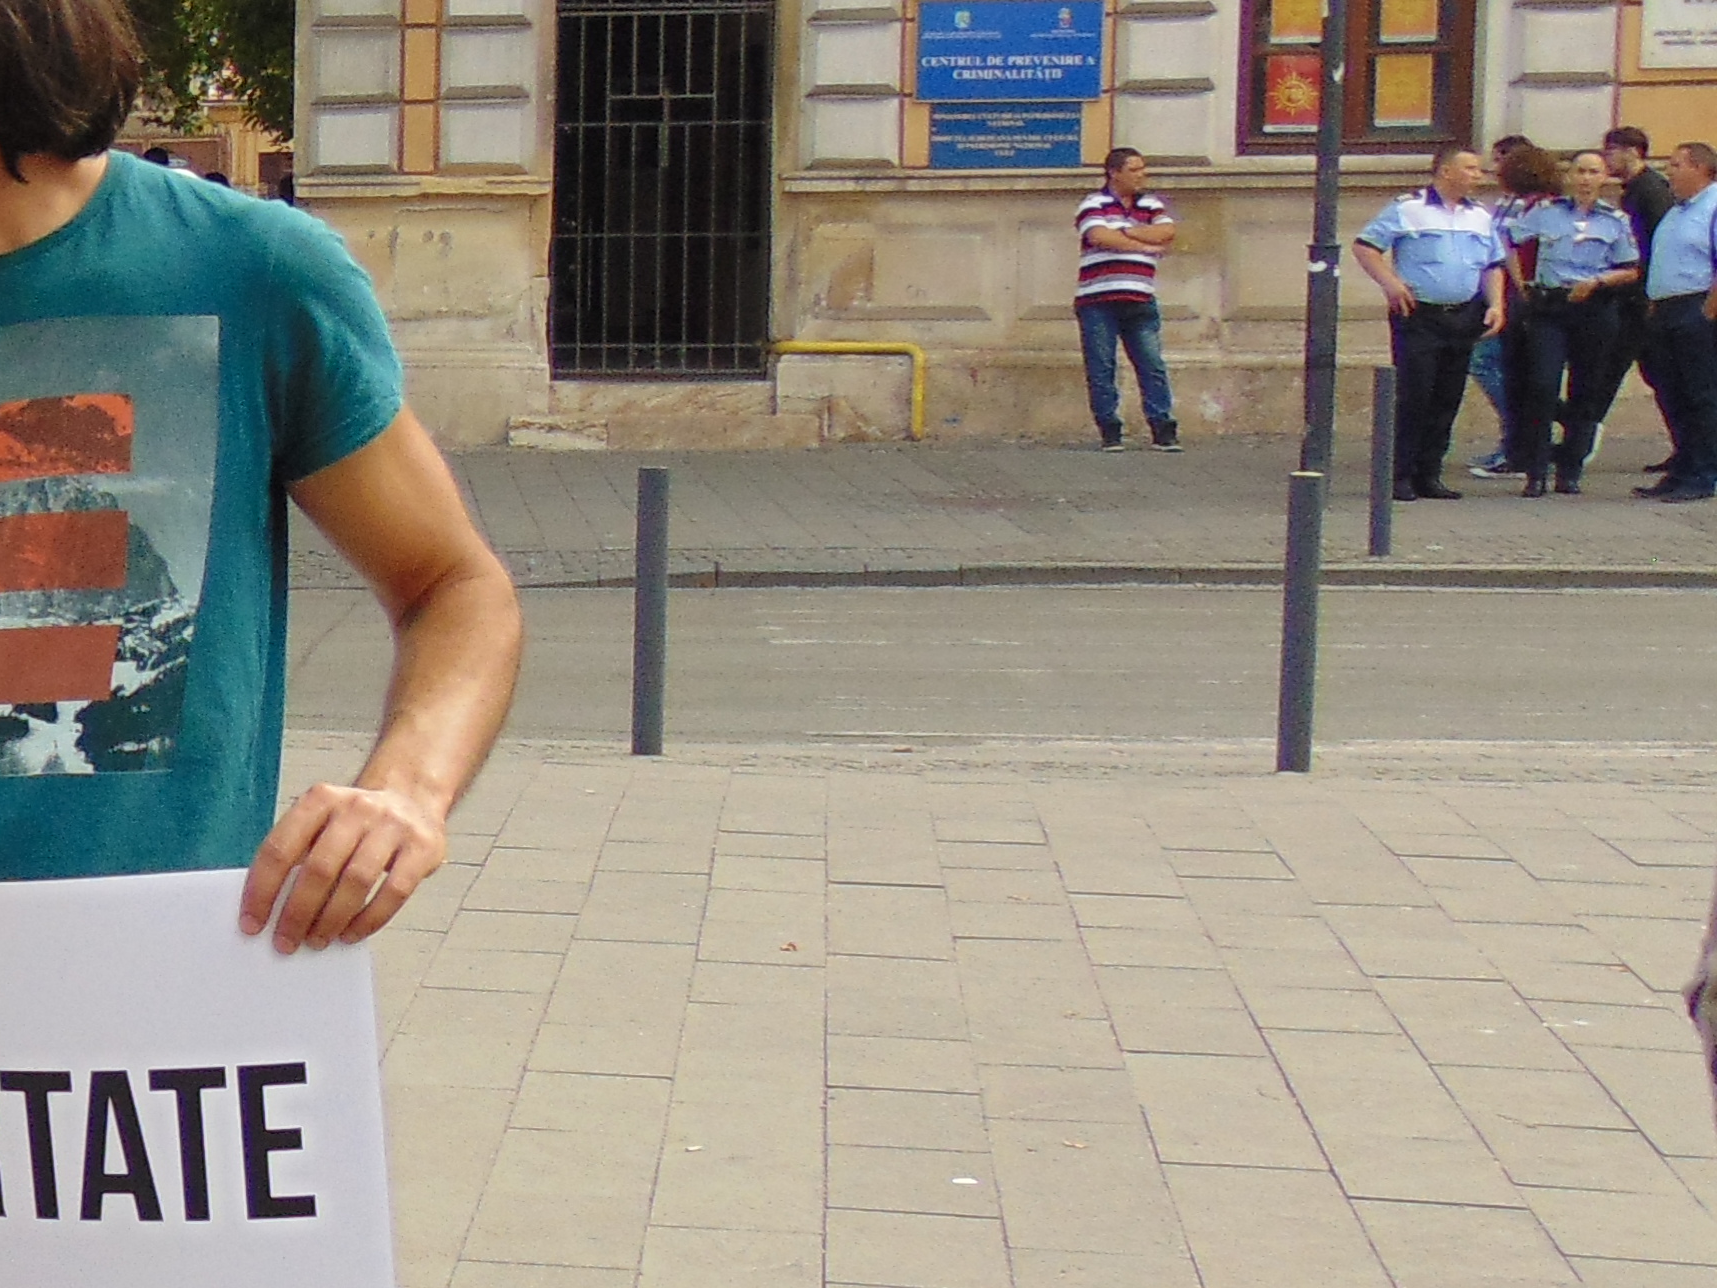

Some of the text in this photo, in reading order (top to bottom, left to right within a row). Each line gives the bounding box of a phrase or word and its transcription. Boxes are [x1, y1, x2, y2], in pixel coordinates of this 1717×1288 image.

[921, 54, 1096, 67] CENTRUL DE PREVENIRE A
